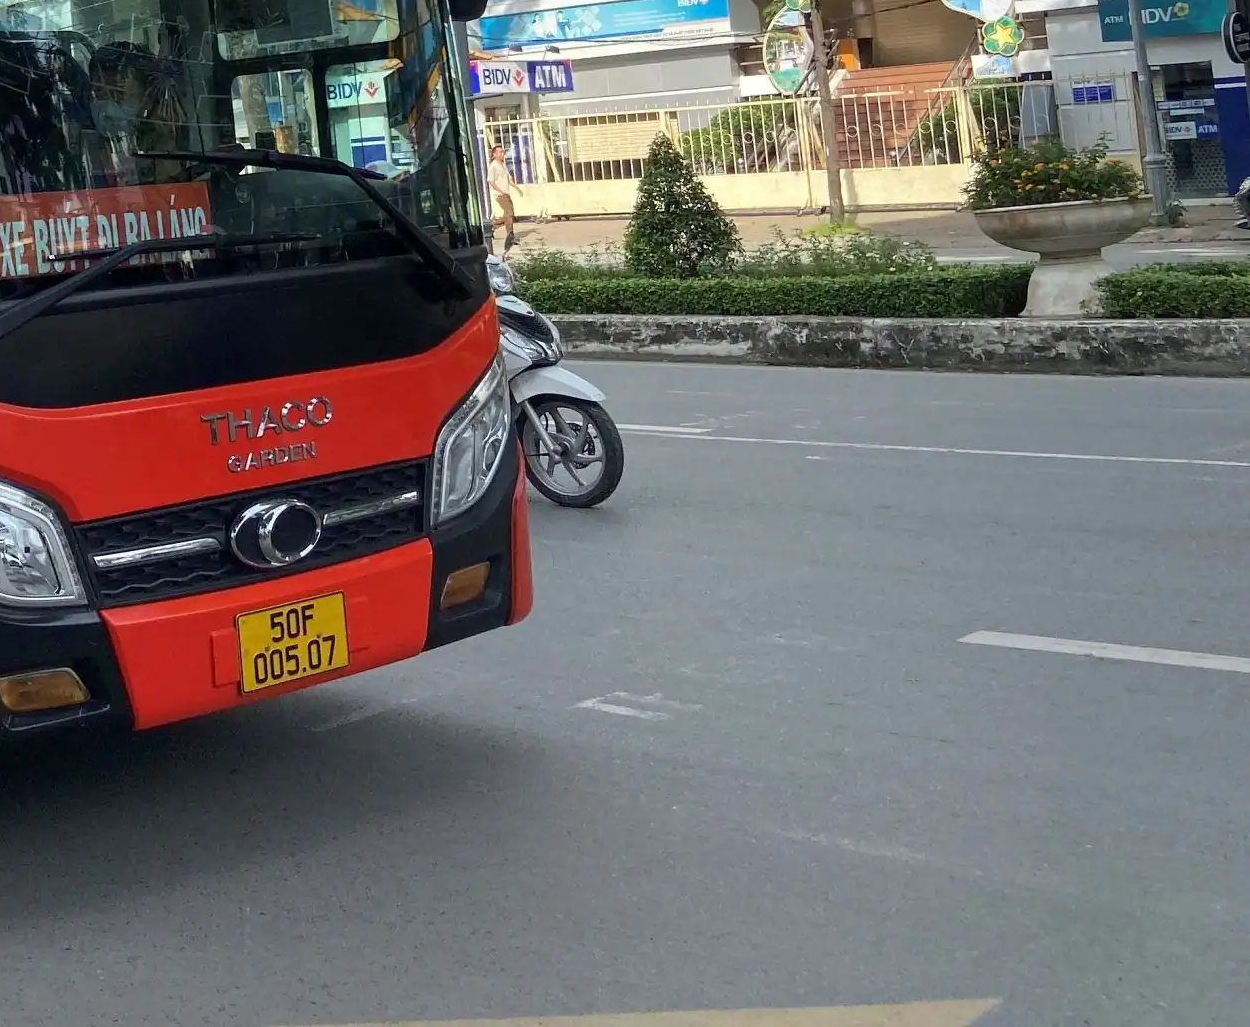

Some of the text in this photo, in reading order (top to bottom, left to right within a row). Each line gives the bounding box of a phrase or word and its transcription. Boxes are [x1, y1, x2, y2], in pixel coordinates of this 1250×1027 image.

[1104, 15, 1124, 25] ATM
[483, 67, 512, 86] BIDV
[534, 64, 567, 89] ATM
[327, 81, 363, 101] BIDV
[1198, 124, 1219, 134] ATM
[201, 396, 333, 445] THACO
[227, 441, 317, 473] GARDEN
[269, 603, 315, 643] 50F
[253, 635, 336, 685] 005.07
